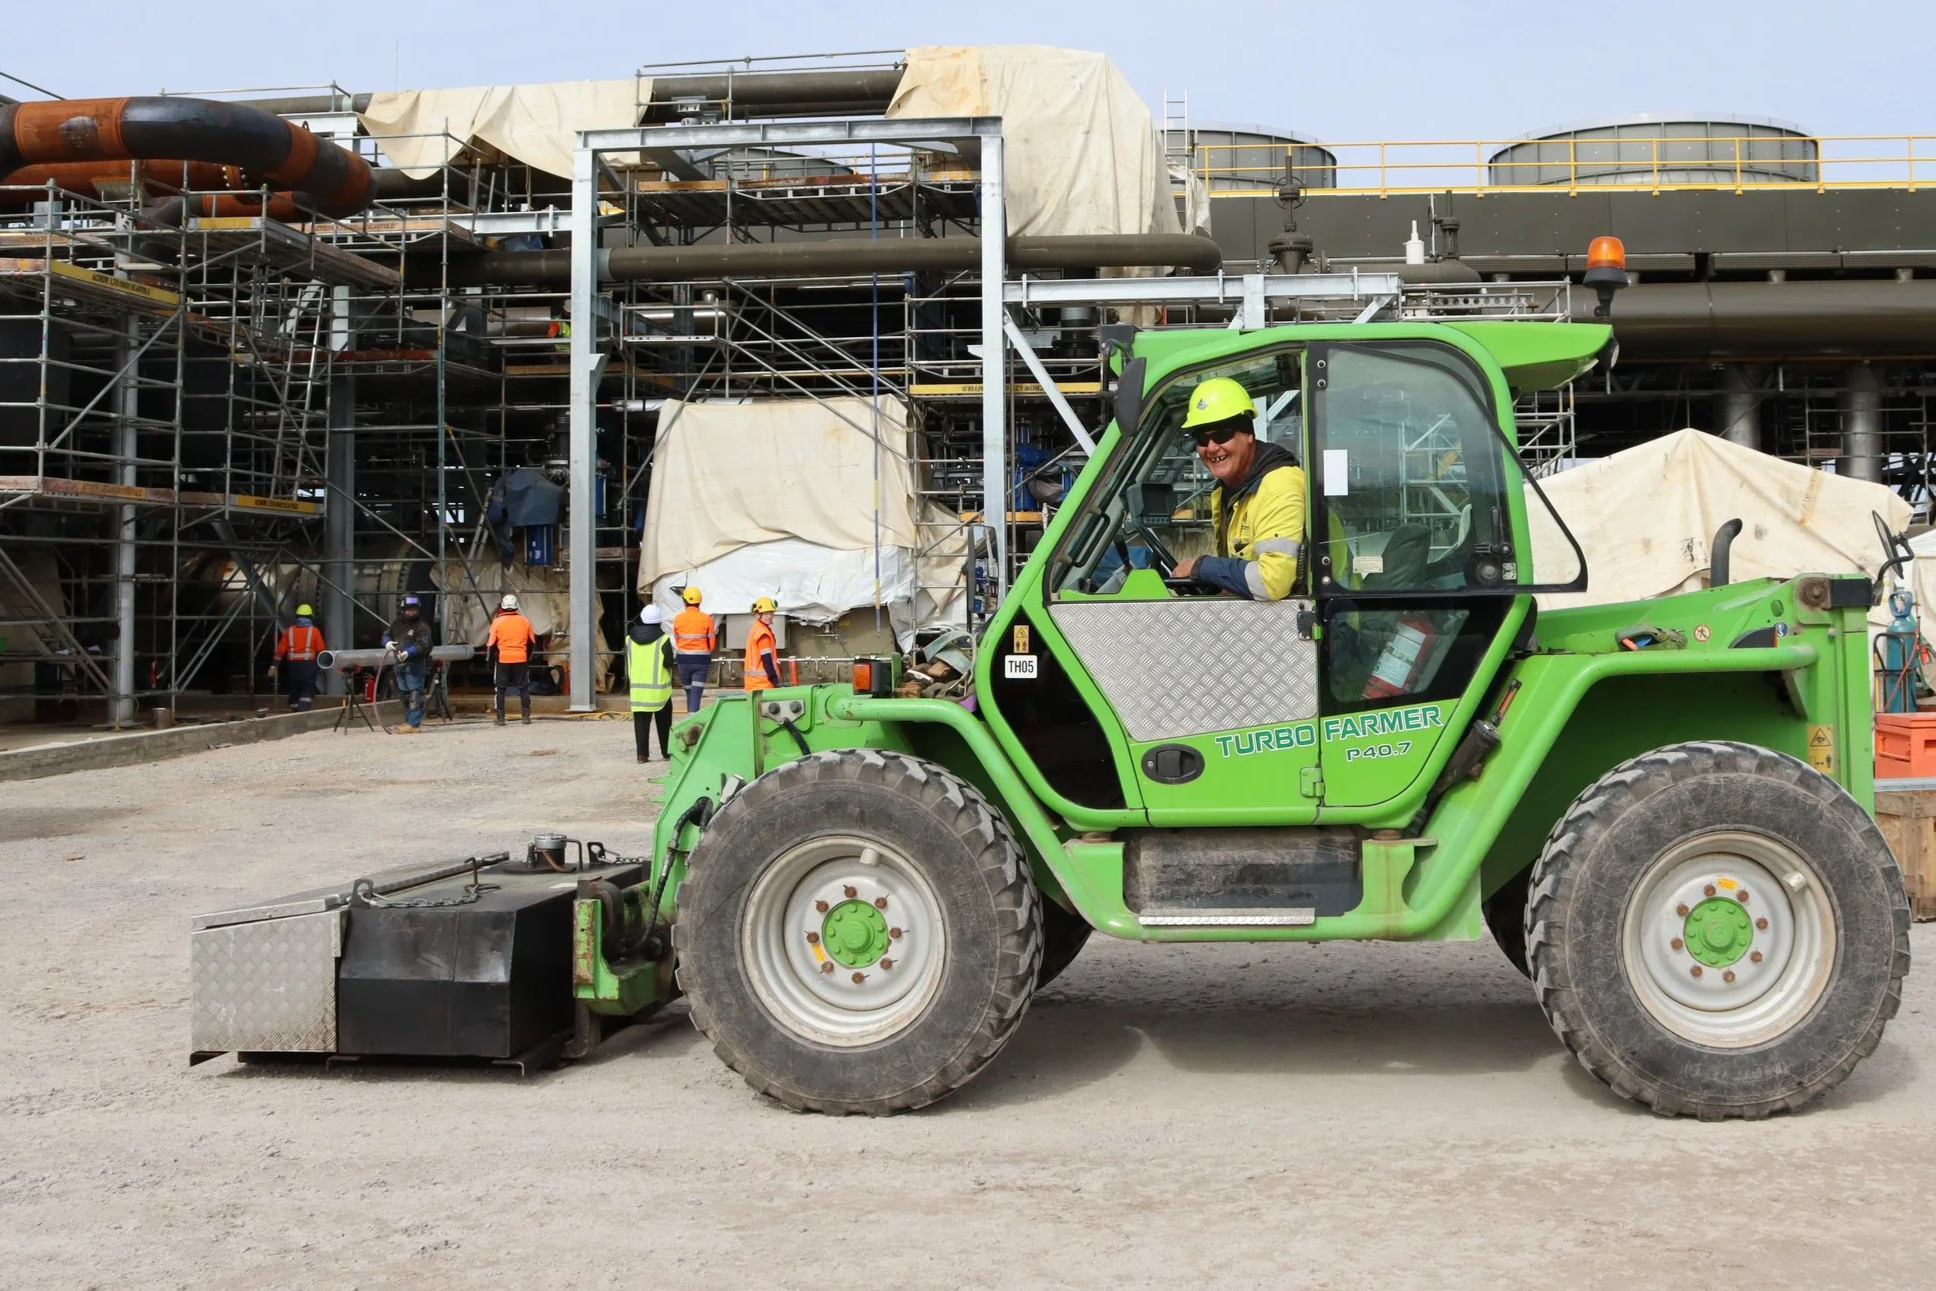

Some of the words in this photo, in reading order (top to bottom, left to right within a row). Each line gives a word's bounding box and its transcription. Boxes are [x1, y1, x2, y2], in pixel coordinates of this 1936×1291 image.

[1008, 660, 1034, 673] TH05
[1215, 724, 1317, 757] TURBO
[1323, 705, 1444, 741] FARMER
[1346, 741, 1412, 762] P40.7
